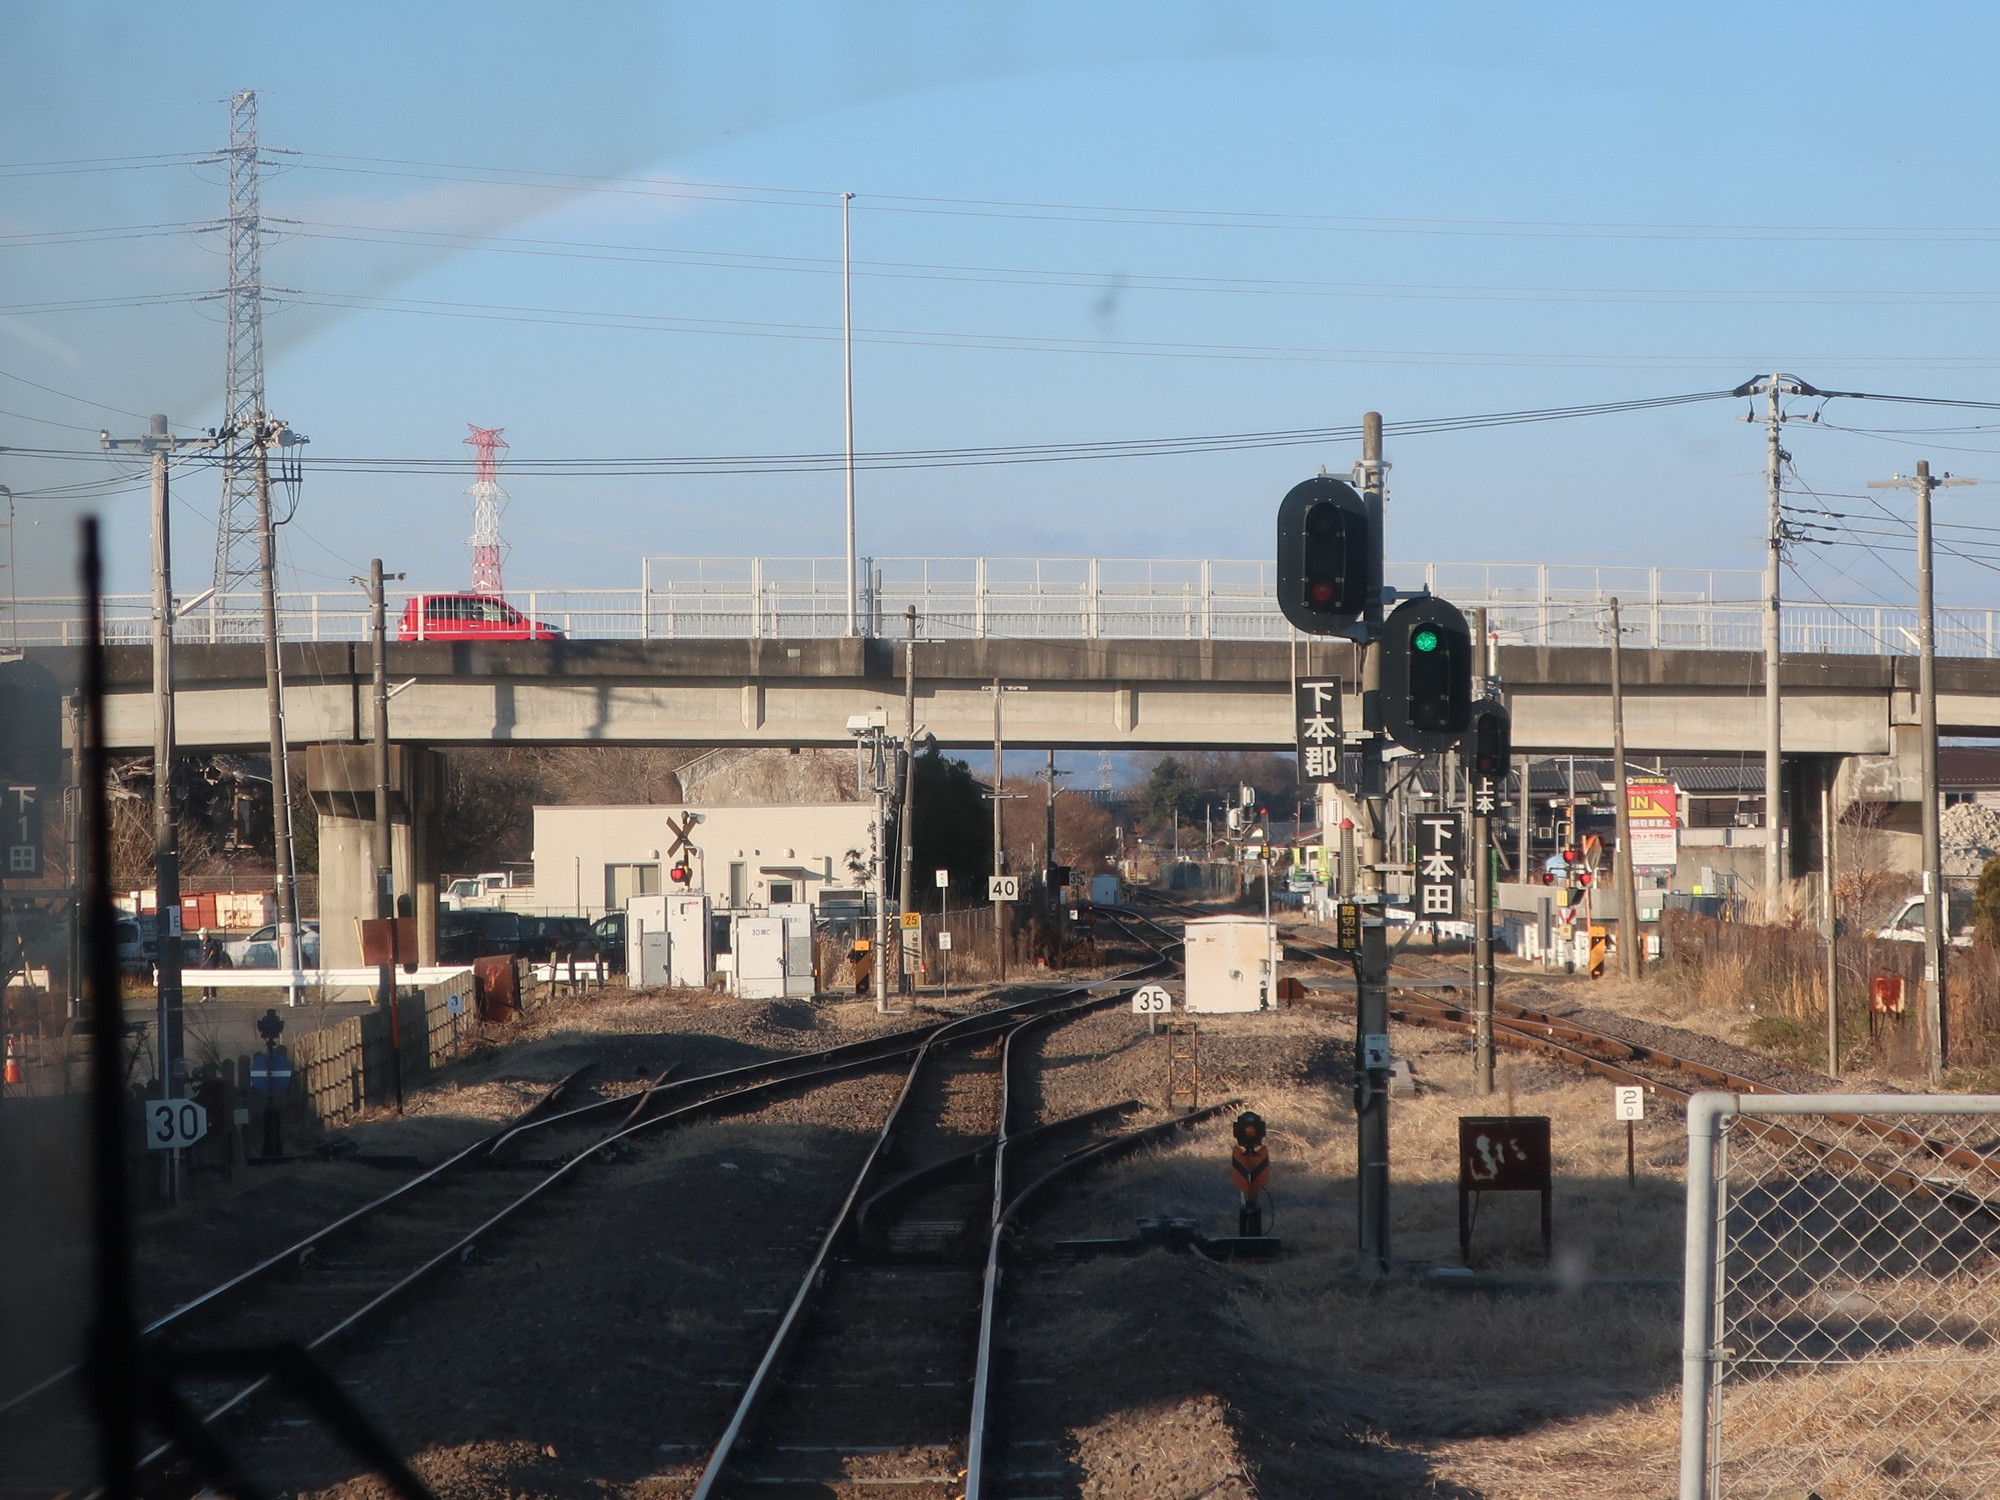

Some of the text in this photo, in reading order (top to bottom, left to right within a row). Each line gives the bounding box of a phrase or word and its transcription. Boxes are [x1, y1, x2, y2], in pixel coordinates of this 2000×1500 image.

[1302, 682, 1337, 777] 下本郡
[1476, 777, 1495, 815] 上本
[1630, 796, 1649, 809] IN
[8, 786, 36, 872] 下1田
[1629, 819, 1671, 827] 断駐車禁止
[1422, 819, 1455, 914] 下本田
[1070, 873, 1083, 884] 35
[992, 880, 1015, 896] 40
[905, 915, 918, 926] 25
[1341, 905, 1357, 949] 踏切中継
[451, 995, 459, 1006] 3
[1139, 991, 1164, 1011] 35
[1623, 1091, 1637, 1104] 2
[155, 1104, 199, 1142] 30
